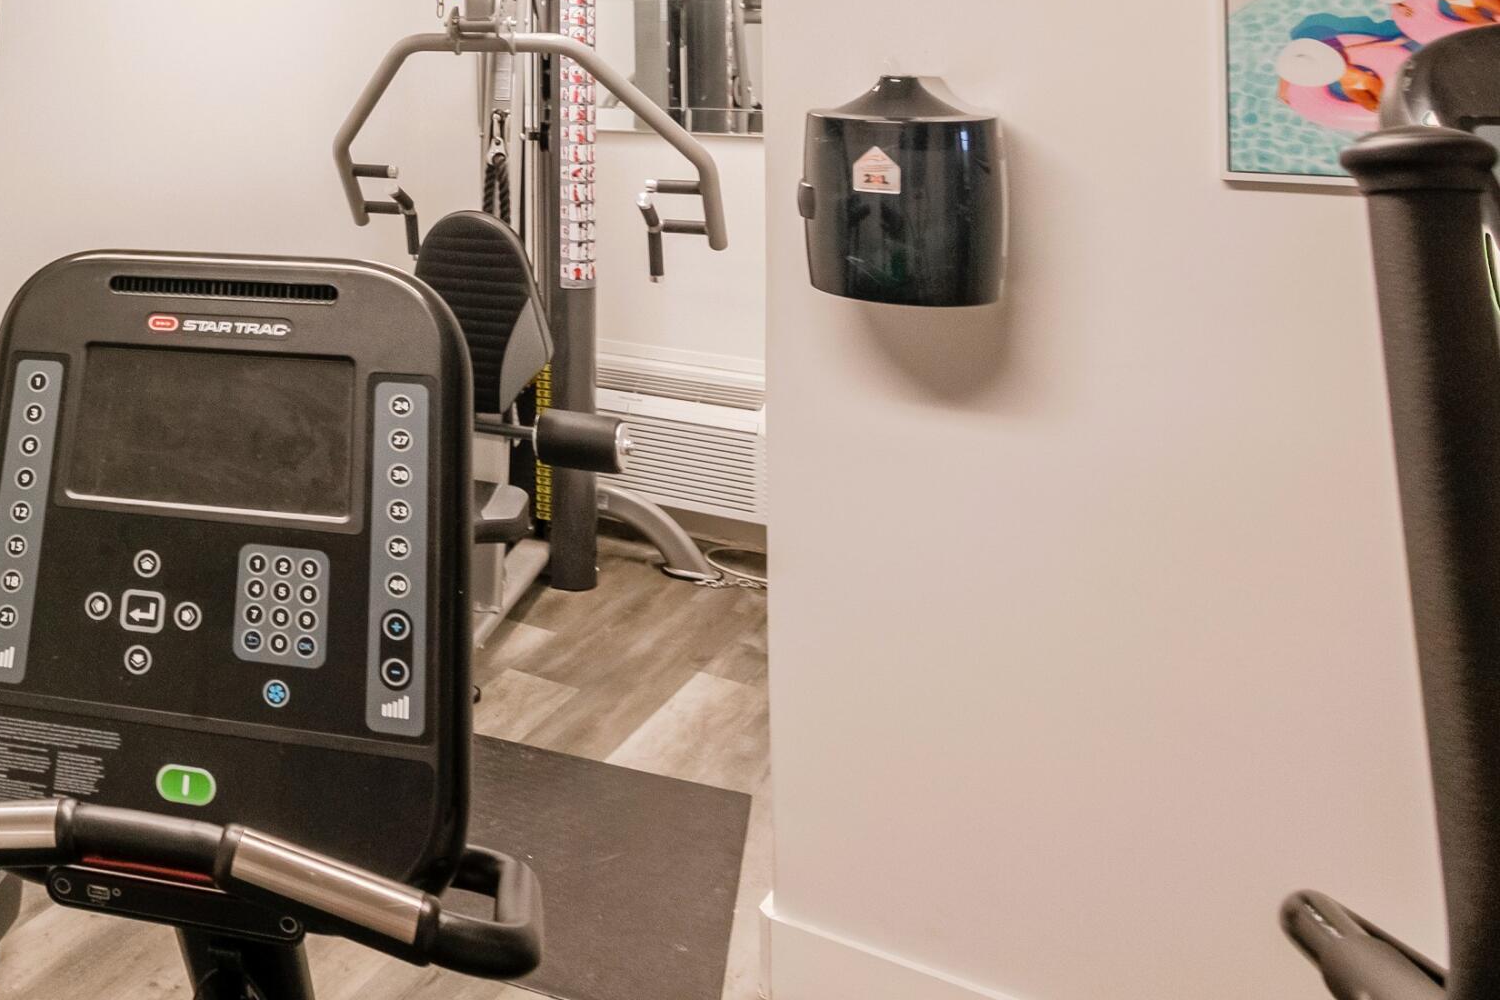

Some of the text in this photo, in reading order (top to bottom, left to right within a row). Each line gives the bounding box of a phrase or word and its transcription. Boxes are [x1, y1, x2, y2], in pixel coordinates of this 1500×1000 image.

[182, 319, 233, 333] STAR
[233, 322, 288, 336] TRAC
[34, 376, 42, 387] 1
[29, 408, 39, 419] 3
[25, 440, 35, 451] 6
[393, 434, 409, 446] 27
[20, 473, 30, 484] 9
[391, 469, 409, 481] 30
[13, 506, 28, 518] 12
[391, 505, 408, 517] 33
[10, 540, 24, 552] 15
[5, 575, 19, 588] 18
[0, 610, 14, 623] 21
